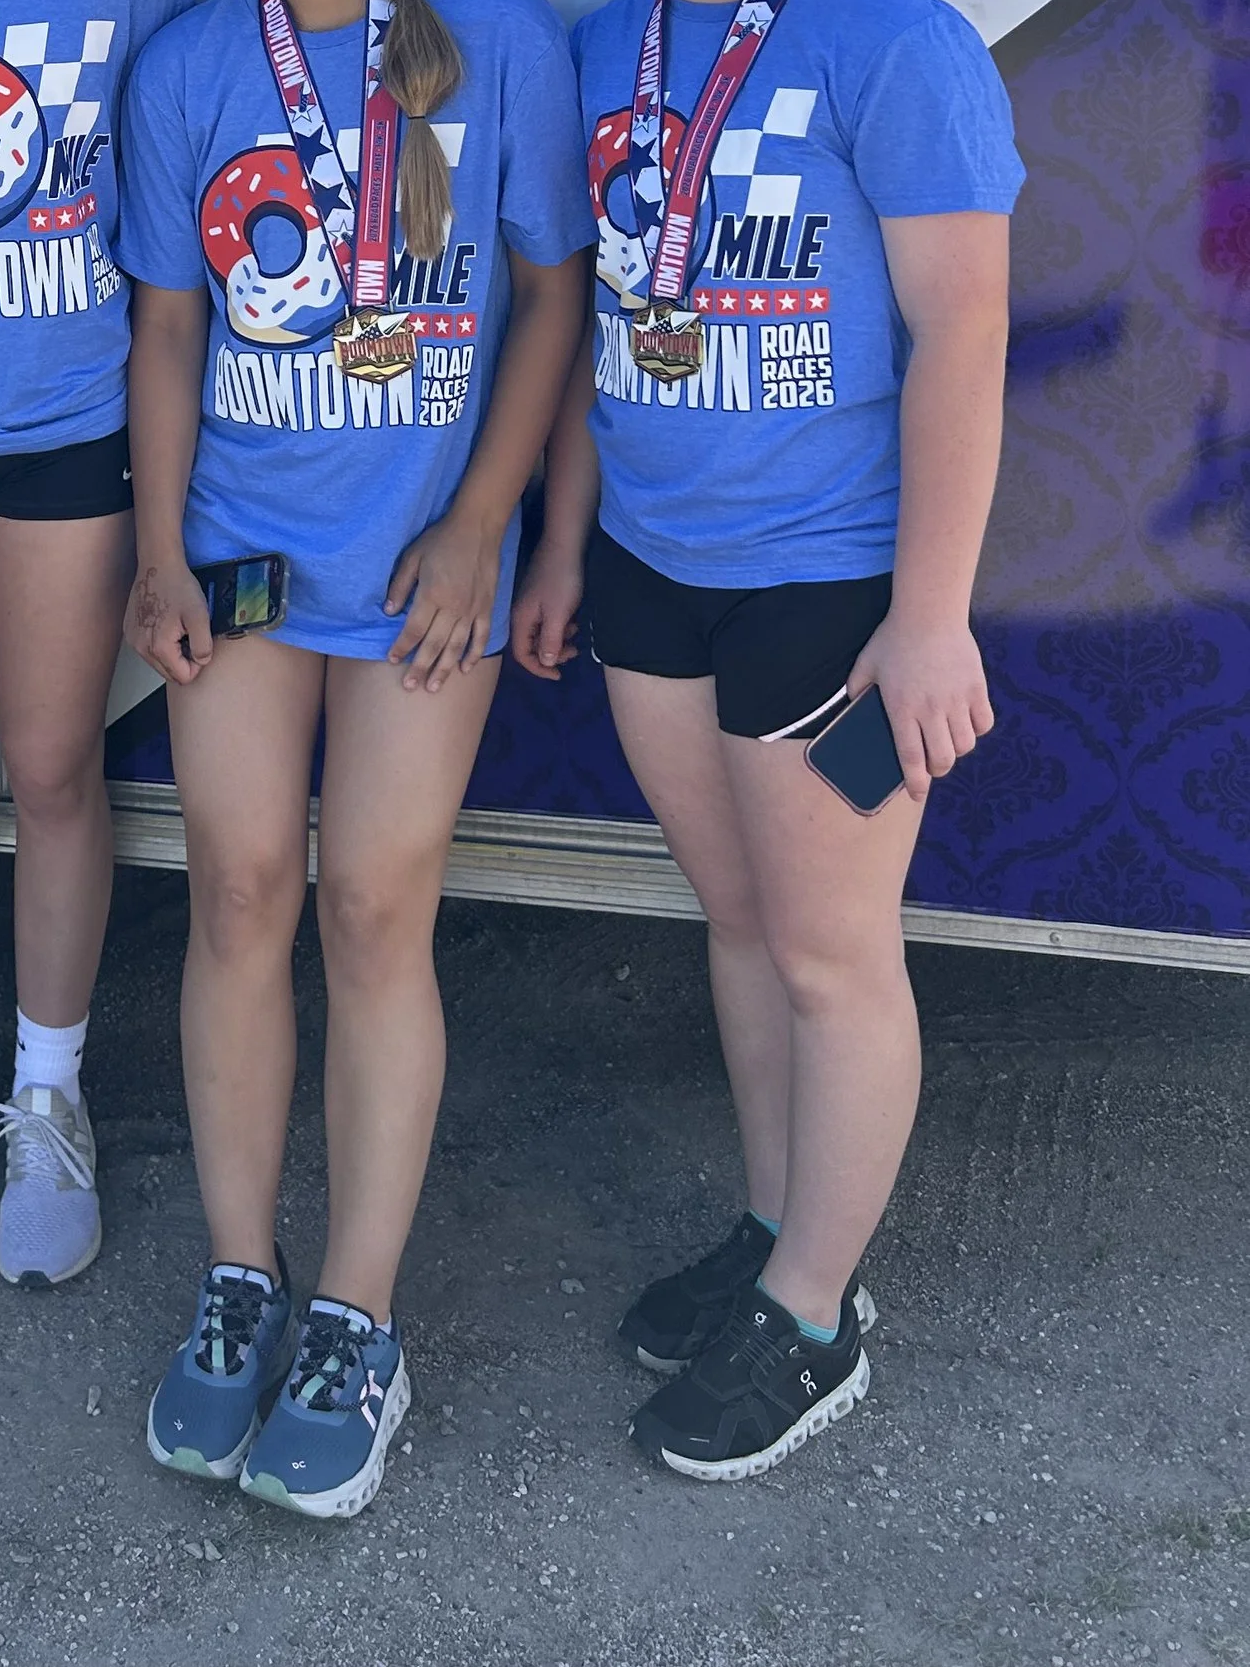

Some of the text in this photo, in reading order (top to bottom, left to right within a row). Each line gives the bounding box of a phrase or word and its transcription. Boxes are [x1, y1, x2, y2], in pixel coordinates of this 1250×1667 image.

[638, 0, 663, 97] BOOMTOWN
[711, 212, 831, 281] MILE
[390, 243, 476, 308] MILE
[760, 321, 832, 359] ROAD
[421, 344, 475, 380] ROAD
[762, 357, 833, 382] RACES
[421, 376, 471, 402] RACES
[761, 380, 836, 411] 2026
[418, 395, 467, 427] 2026
